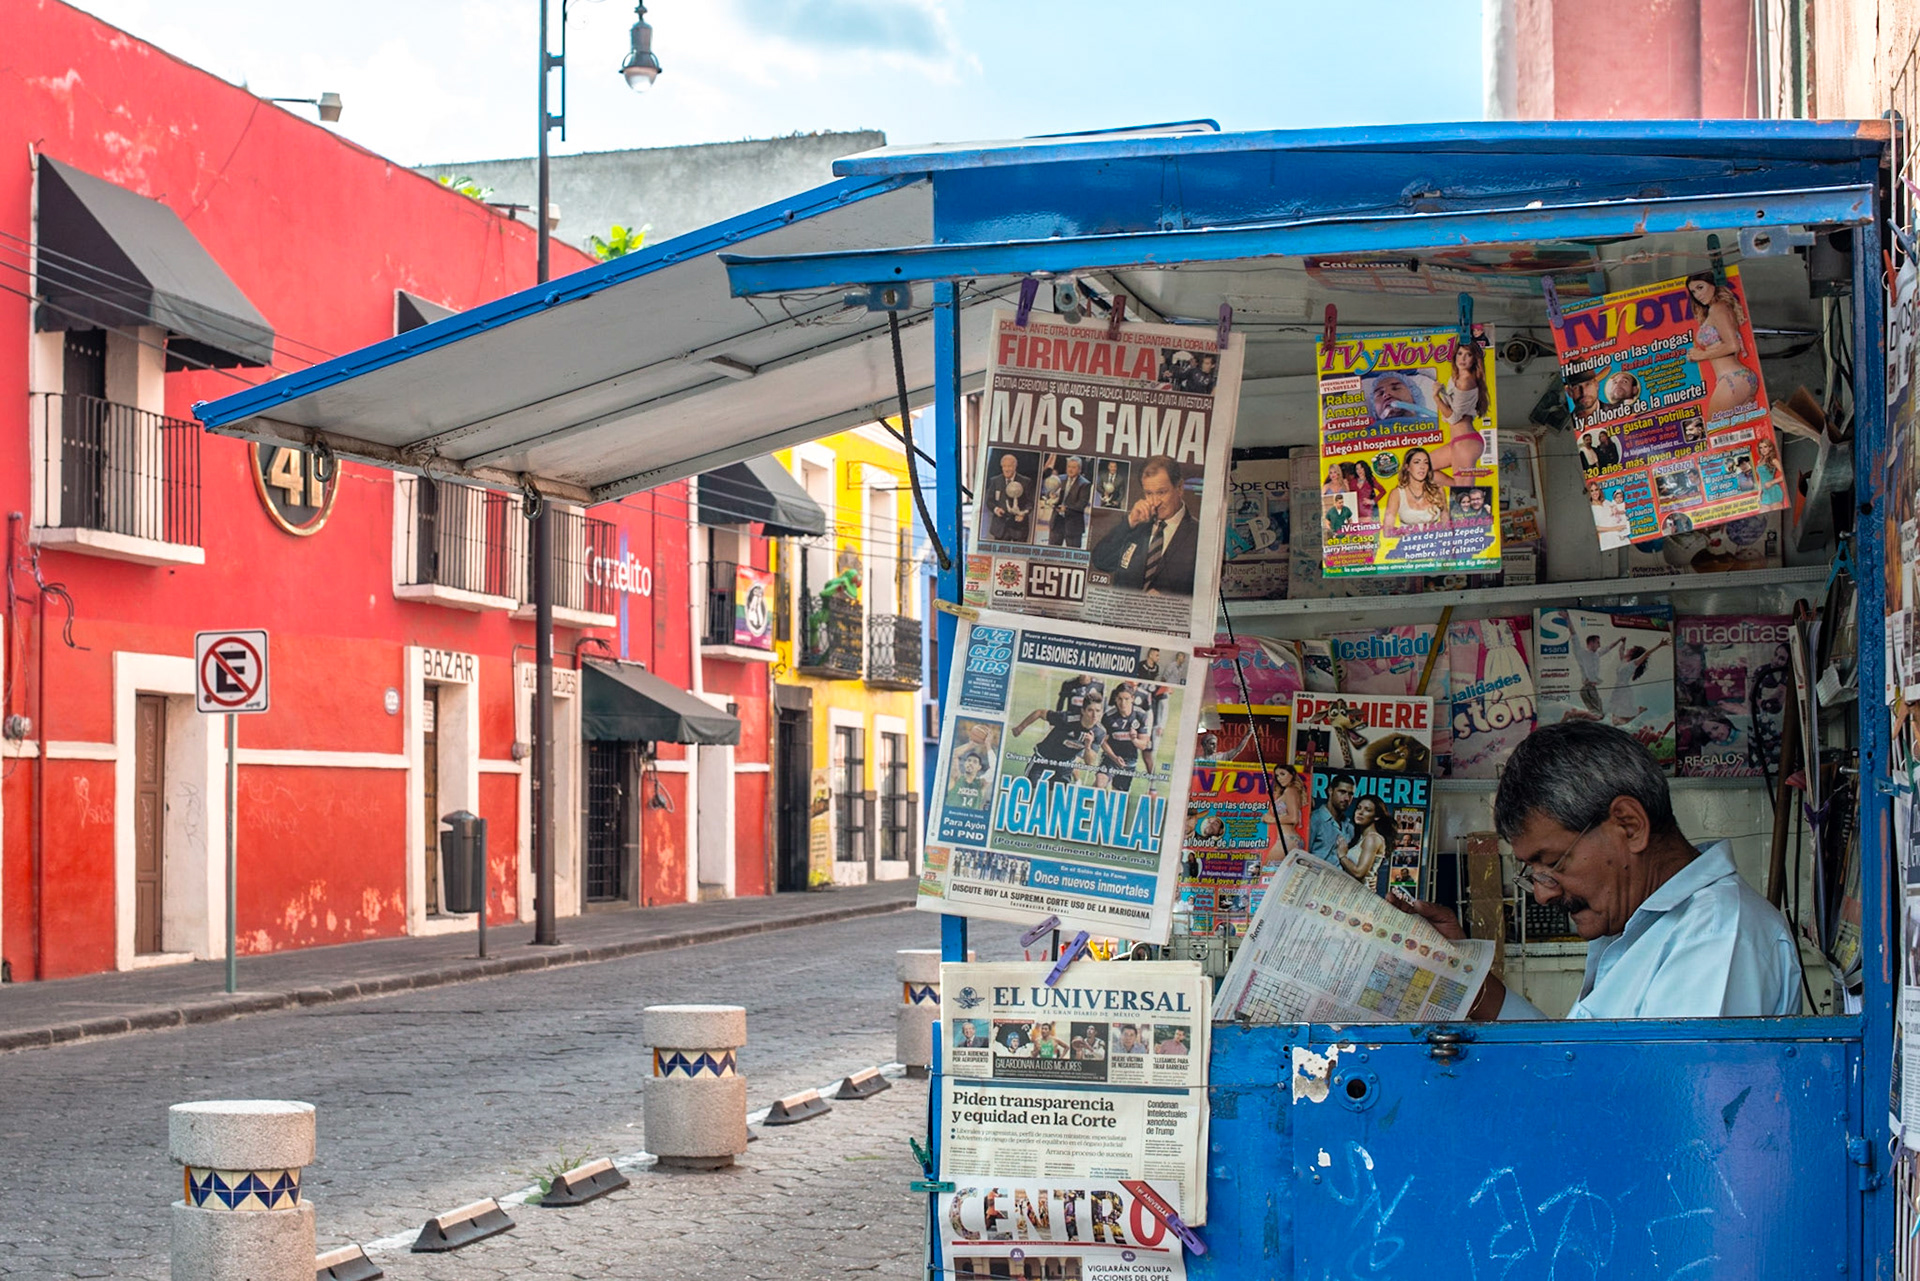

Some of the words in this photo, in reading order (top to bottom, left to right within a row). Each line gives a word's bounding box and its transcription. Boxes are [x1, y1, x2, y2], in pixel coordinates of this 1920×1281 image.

[1319, 260, 1411, 269] Calendari
[1030, 323, 1049, 335] ANTE
[1050, 325, 1068, 337] OTRA
[1123, 333, 1133, 344] DE
[1134, 334, 1171, 347] LEVANTAR
[1172, 337, 1182, 349] LA
[1183, 339, 1203, 350] COPA
[1590, 337, 1617, 351] verdad!
[1560, 352, 1611, 378] ¡Hundido
[1615, 350, 1628, 363] en
[1630, 342, 1648, 359] las
[1650, 329, 1694, 354] drogas!
[1621, 354, 1653, 372] Rafael
[1654, 347, 1687, 363] Amaya
[1125, 389, 1150, 403] DURANTE
[1326, 391, 1365, 406] Rafael
[1599, 402, 1633, 423] borde
[1634, 398, 1648, 415] de
[1650, 394, 1661, 408] la
[1663, 380, 1707, 404] muerte!
[1326, 405, 1368, 420] Amaya
[1712, 409, 1733, 420] Arlene
[1735, 401, 1758, 414] Maciel
[989, 390, 1084, 451] MÁS
[1096, 400, 1206, 465] FAMA
[1327, 421, 1338, 430] La
[1339, 418, 1370, 429] realidad
[1606, 424, 1621, 437] ¡Le
[1622, 417, 1654, 435] gustan
[1327, 427, 1368, 443] superó
[1370, 427, 1377, 436] a
[1378, 424, 1390, 436] la
[1393, 421, 1435, 435] ficción
[1325, 442, 1352, 456] ¡Llegó
[1354, 441, 1362, 452] al
[1363, 436, 1400, 453] hospital
[1401, 433, 1443, 450] drogado!
[1601, 462, 1623, 475] años
[1625, 456, 1644, 470] más
[1646, 451, 1672, 466] joven
[1674, 447, 1692, 459] que
[1694, 440, 1708, 453] él!
[1242, 482, 1262, 491] DE
[1327, 538, 1339, 546] en
[1353, 534, 1375, 543] caso
[1402, 535, 1411, 543] La
[1423, 532, 1434, 540] de
[1434, 530, 1453, 540] Juan
[1454, 526, 1484, 538] Zepeda
[1323, 546, 1341, 554] Larry
[1403, 542, 1437, 552] asegura:
[1464, 536, 1485, 546] poco
[1404, 550, 1438, 560] hombre,
[995, 589, 1024, 598] OEM
[1681, 622, 1790, 643] ntaditas
[424, 649, 475, 682] BAZAR
[1021, 642, 1034, 659] DE
[1035, 644, 1078, 666] LESIONES
[1079, 651, 1087, 666] A
[1087, 651, 1135, 674] HOMICIDIO
[1296, 699, 1428, 729] PRMIERE
[1005, 752, 1027, 763] Chivas
[1033, 755, 1048, 765] León
[1058, 760, 1089, 771] enfrentan
[1685, 753, 1745, 767] REGALOS
[962, 797, 973, 807] 14
[1225, 800, 1237, 810] las
[1239, 800, 1270, 812] drogas!
[994, 770, 1166, 853] ¡GÁNENLA!
[943, 817, 963, 827] Para
[964, 820, 986, 831] Ayón
[942, 829, 954, 837] el
[957, 831, 984, 841] PND
[993, 837, 1033, 850] (Porque
[1193, 838, 1214, 847] borde
[1216, 838, 1227, 848] de
[1228, 838, 1237, 848] la
[1238, 837, 1269, 849] muerte!
[1206, 852, 1228, 860] gustan
[1034, 870, 1060, 885] Once
[1061, 877, 1096, 890] nuevos
[1097, 878, 1150, 898] inmortales
[952, 883, 982, 896] DISCUTE
[983, 887, 999, 898] HOY
[999, 890, 1009, 900] LA
[1010, 891, 1045, 904] SUPREMA
[1046, 896, 1069, 907] CORTE
[1071, 899, 1086, 910] USO
[1087, 902, 1096, 911] DE
[1098, 903, 1107, 913] LA
[1108, 905, 1150, 919] MARIGUANA
[993, 986, 1025, 1007] EL
[1031, 987, 1192, 1013] UNIVERSAL
[1113, 1010, 1140, 1018] MÉXICO
[994, 1058, 1035, 1069] GALARDONAN
[1035, 1060, 1040, 1069] A
[1040, 1059, 1053, 1070] LOS
[1053, 1060, 1082, 1072] MEJORES
[952, 1091, 997, 1107] Piden
[1000, 1093, 1114, 1114] transparencia
[1147, 1099, 1179, 1109] Condenan
[951, 1111, 962, 1125] y
[964, 1107, 1028, 1127] equidad
[1031, 1112, 1050, 1125] en
[1052, 1110, 1069, 1126] la
[1071, 1112, 1117, 1129] Corte
[1146, 1118, 1178, 1127] xenofobia
[1146, 1127, 1155, 1135] de
[1155, 1127, 1175, 1137] Trump
[1046, 1148, 1070, 1157] Arranca
[1071, 1150, 1097, 1159] proceso
[1105, 1150, 1133, 1159] sucesión
[1142, 1192, 1170, 1218] ANIVERSAR
[948, 1186, 1167, 1248] CENTRO
[1088, 1262, 1131, 1273] VIGILARÁN
[1132, 1264, 1150, 1273] CON
[1153, 1265, 1172, 1273] LUPA
[1091, 1273, 1128, 1281] ACCIONES
[1129, 1273, 1146, 1281] DEL
